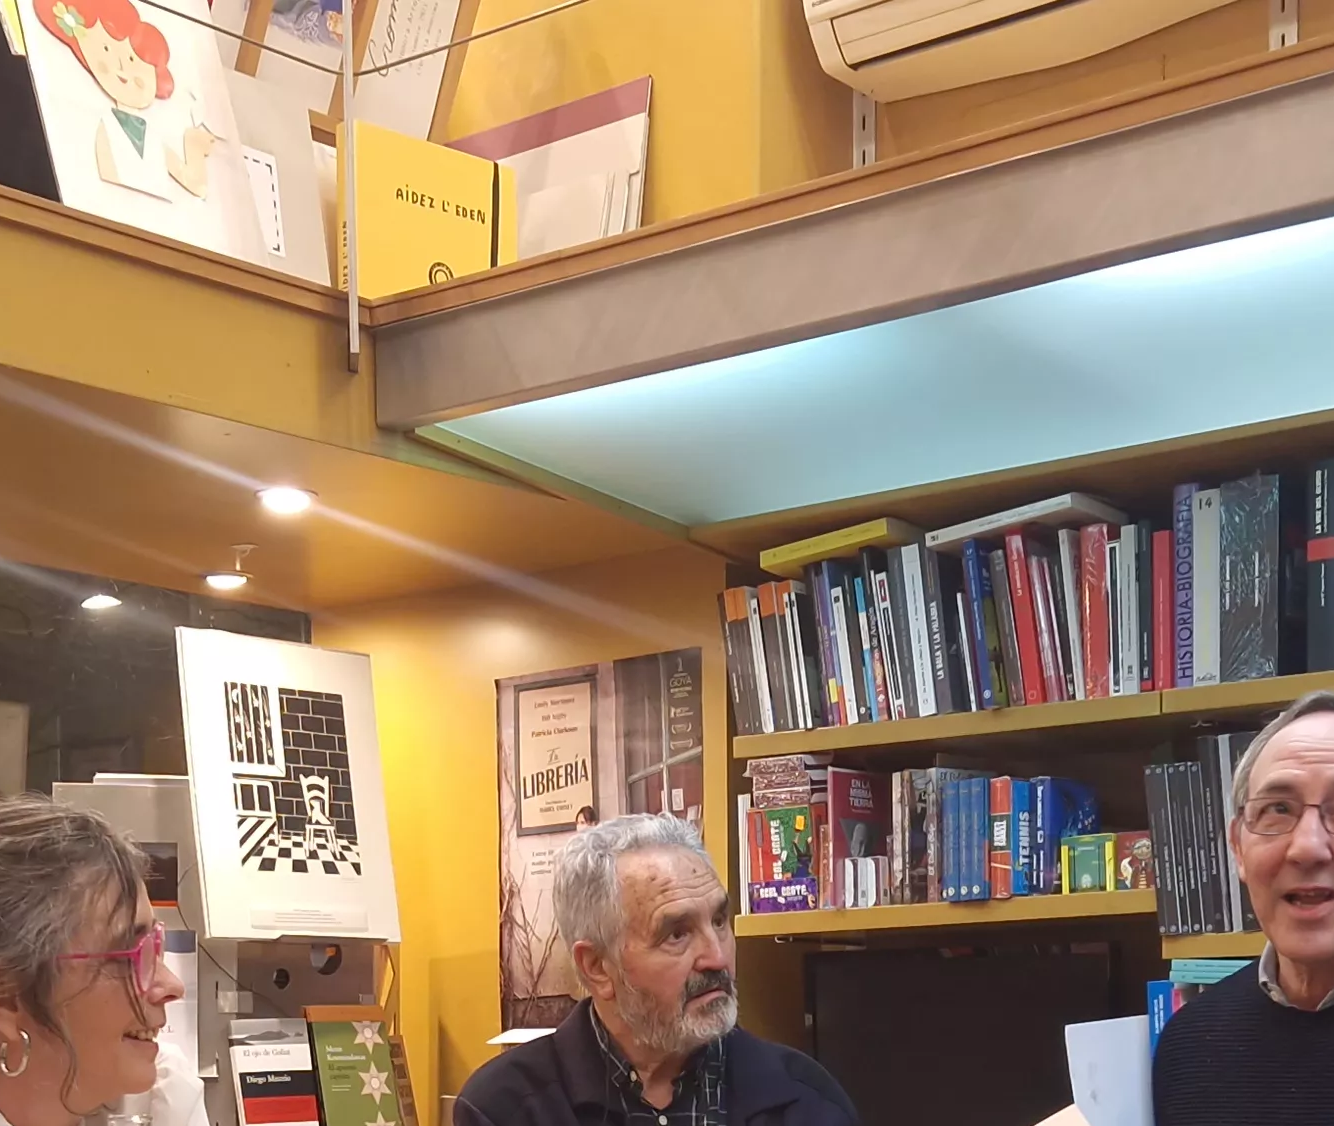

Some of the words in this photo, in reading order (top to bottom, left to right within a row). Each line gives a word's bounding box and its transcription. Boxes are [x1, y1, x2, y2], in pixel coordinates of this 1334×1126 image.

[456, 204, 486, 225] EDEN
[670, 676, 692, 687] GOYA
[523, 754, 589, 800] LIBRERÍA
[1019, 811, 1030, 865] TENNIS
[247, 1075, 266, 1084] Diego
